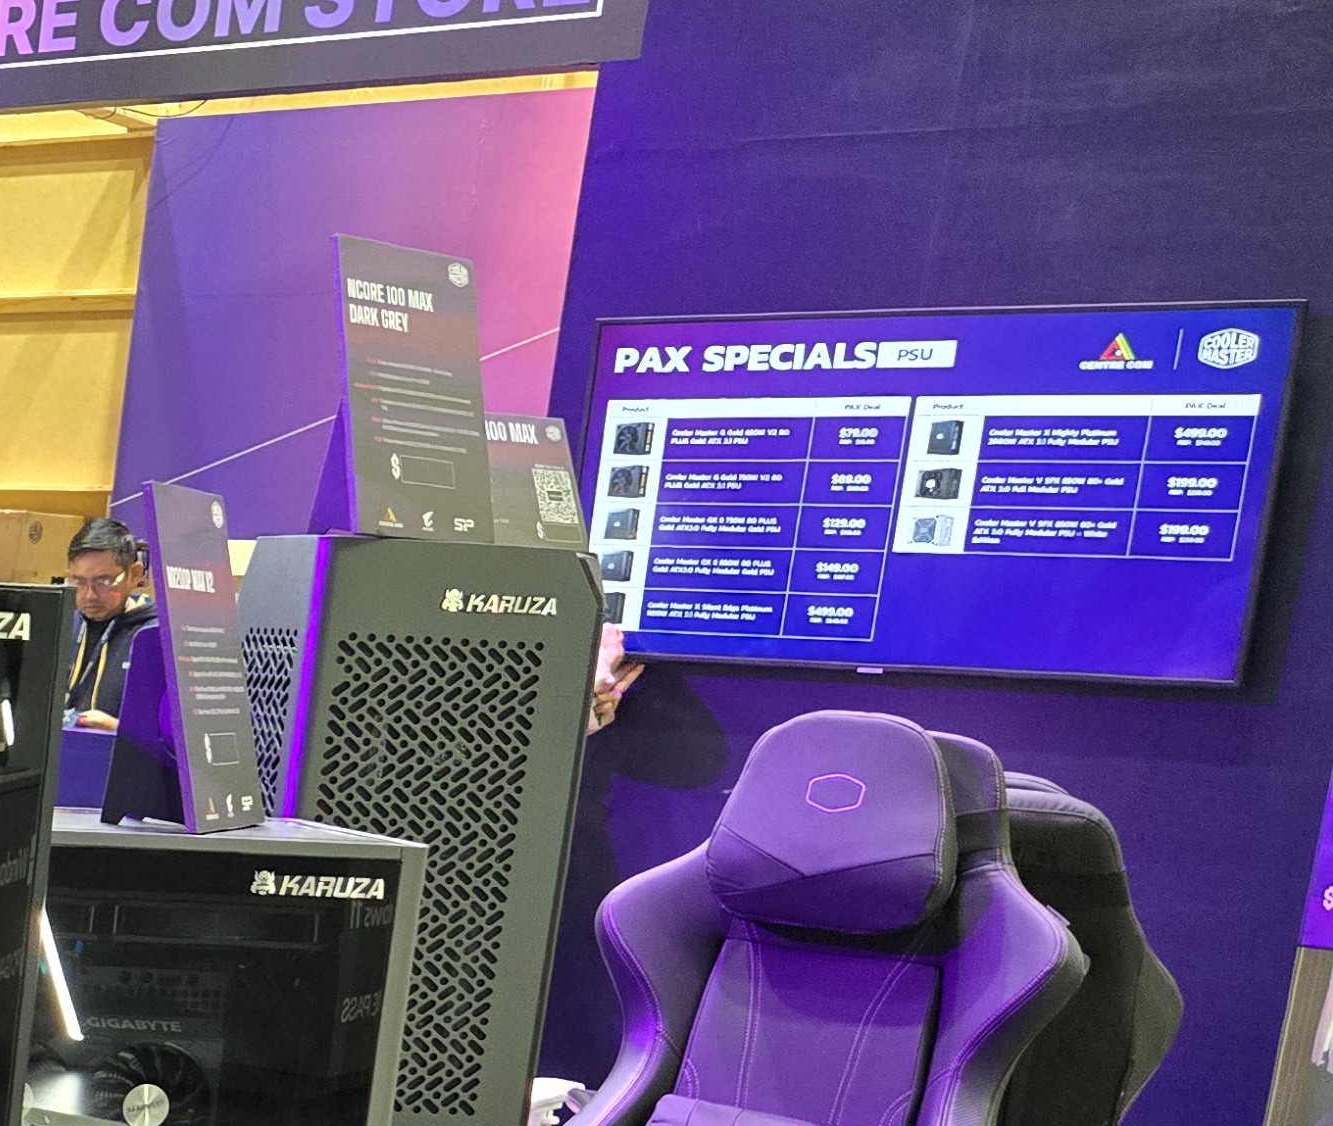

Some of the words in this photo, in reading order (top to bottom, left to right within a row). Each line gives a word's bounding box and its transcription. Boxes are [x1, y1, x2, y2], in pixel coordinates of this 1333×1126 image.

[100, 0, 280, 46] COM
[347, 278, 384, 304] NCORE
[386, 285, 406, 307] 100
[408, 290, 433, 312] MAX
[349, 303, 379, 327] DARK
[380, 309, 409, 333] GREY
[1204, 333, 1255, 351] COOLER
[614, 346, 692, 373] PAX
[702, 342, 877, 372] SPECIALS
[897, 348, 934, 361] PSU
[1079, 360, 1124, 370] CENTRE
[1126, 360, 1153, 370] COM
[1202, 347, 1255, 366] MASTER
[509, 422, 538, 445] MAX
[466, 593, 558, 617] KARUZA
[278, 874, 385, 900] KARUZA
[86, 1016, 182, 1034] GIGABYTE
